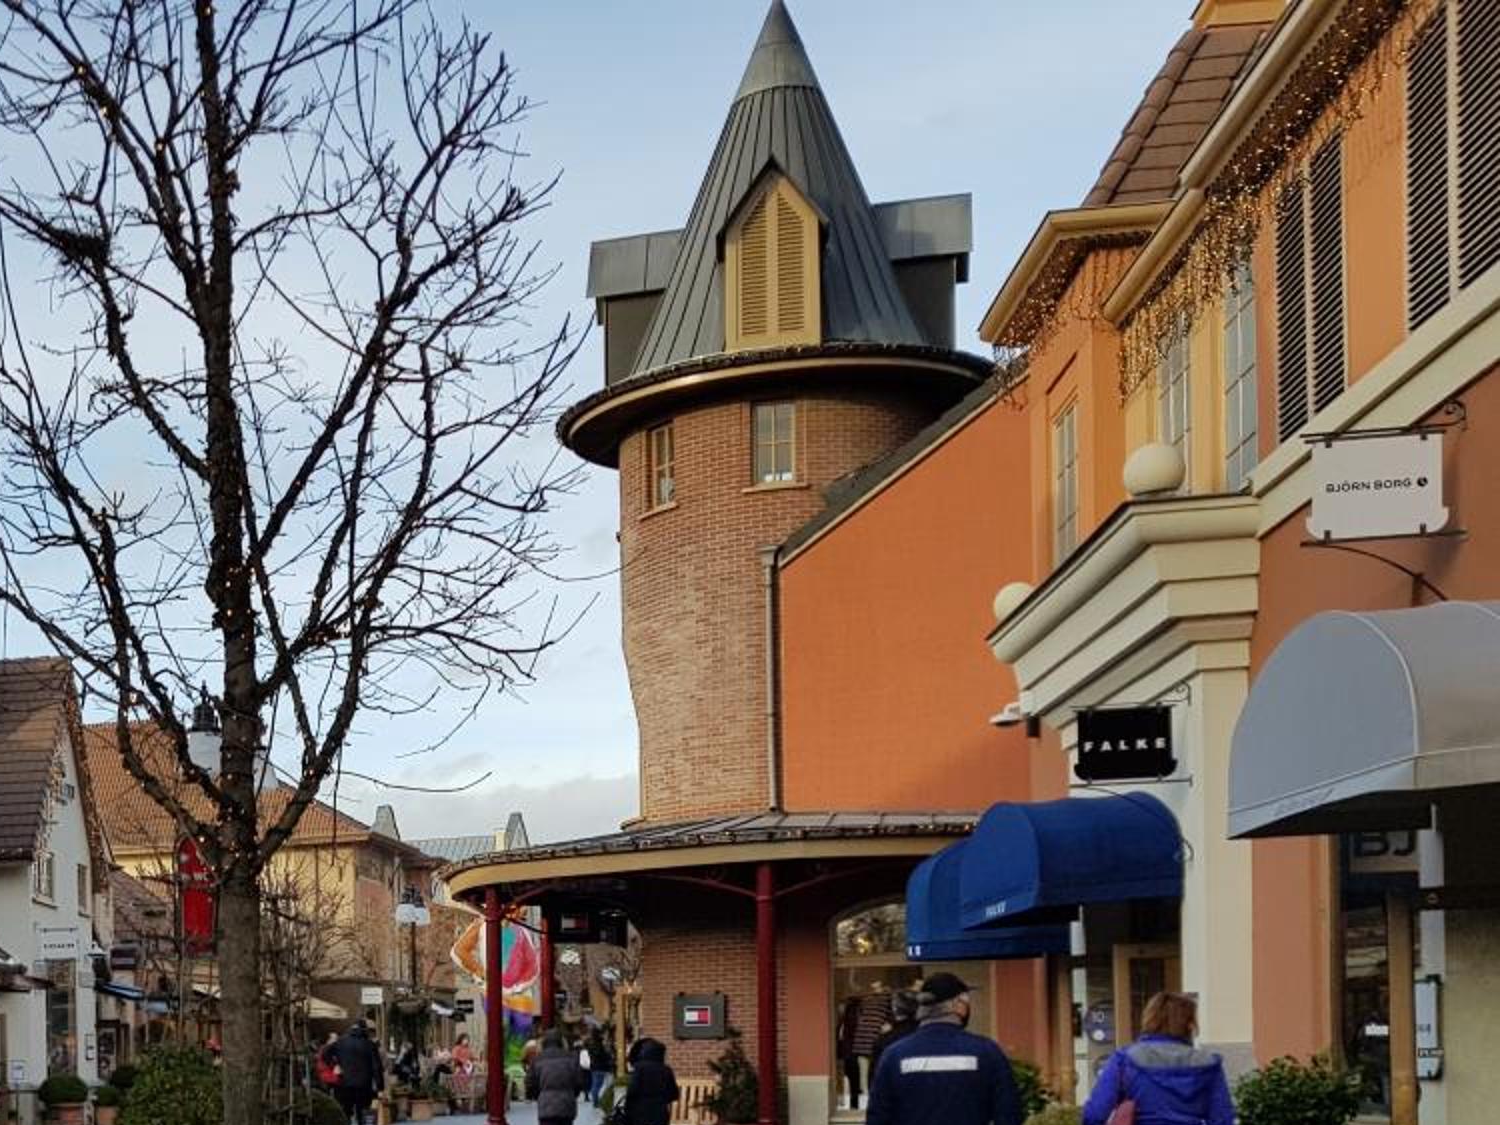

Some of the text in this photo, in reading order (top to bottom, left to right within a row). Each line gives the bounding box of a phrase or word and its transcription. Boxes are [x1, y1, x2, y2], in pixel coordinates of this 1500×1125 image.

[1326, 477, 1412, 493] BJÖRN BORG
[1083, 737, 1166, 753] FALKE
